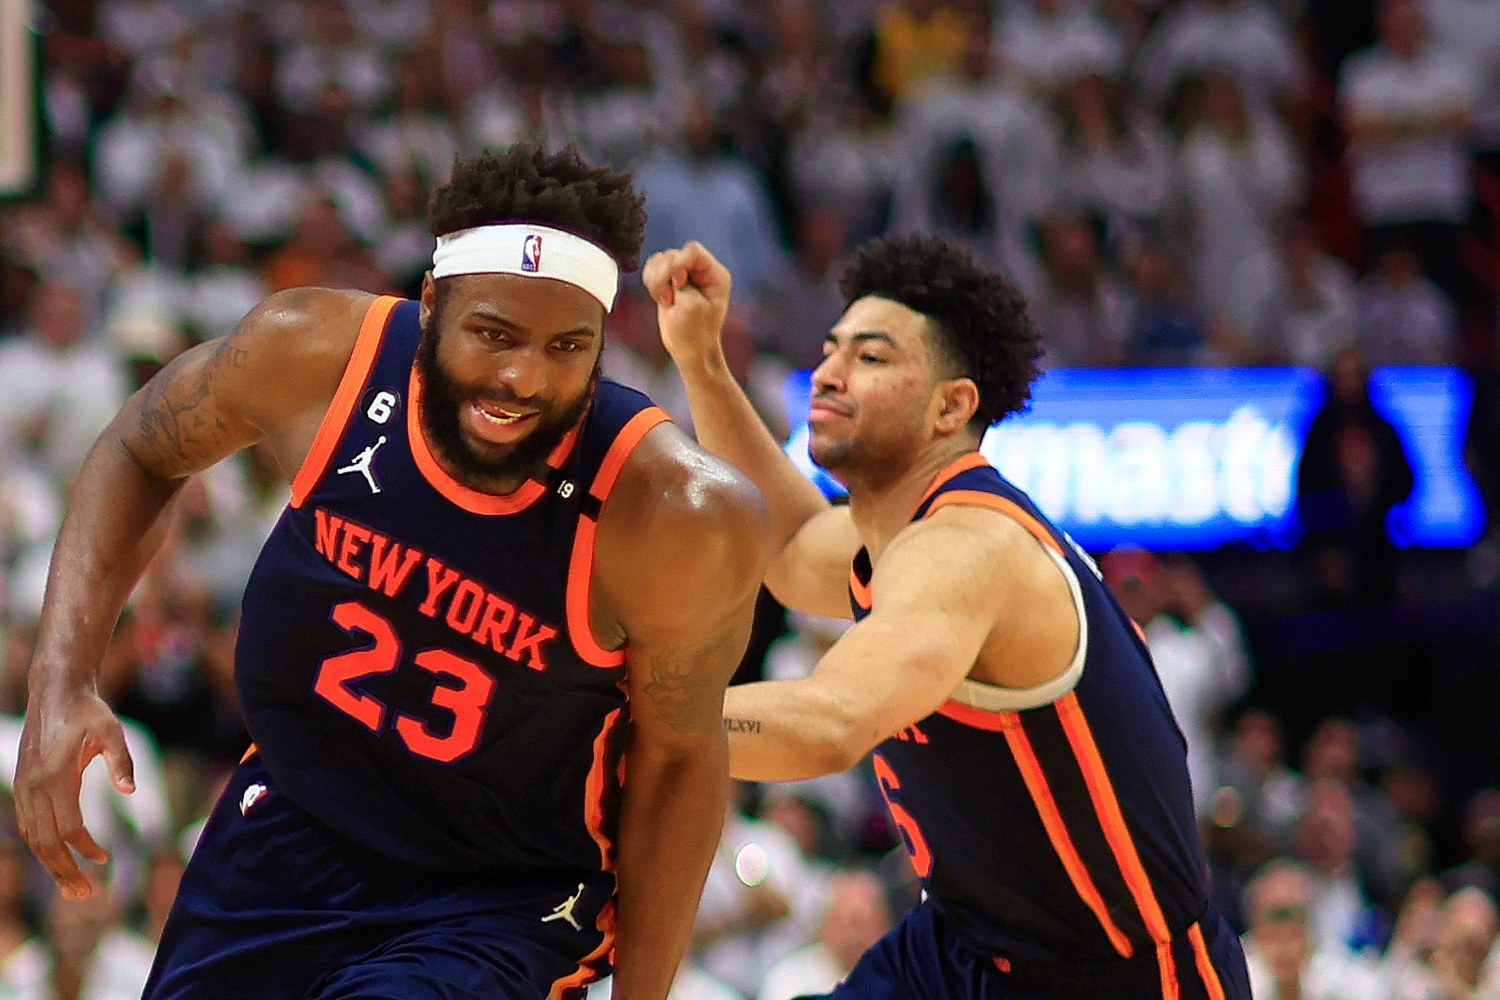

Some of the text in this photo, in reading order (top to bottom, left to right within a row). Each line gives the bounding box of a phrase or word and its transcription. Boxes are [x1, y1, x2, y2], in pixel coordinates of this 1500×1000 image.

[367, 391, 395, 425] 6
[556, 479, 575, 499] 19
[314, 508, 561, 671] NEW YORK
[312, 600, 497, 763] 23
